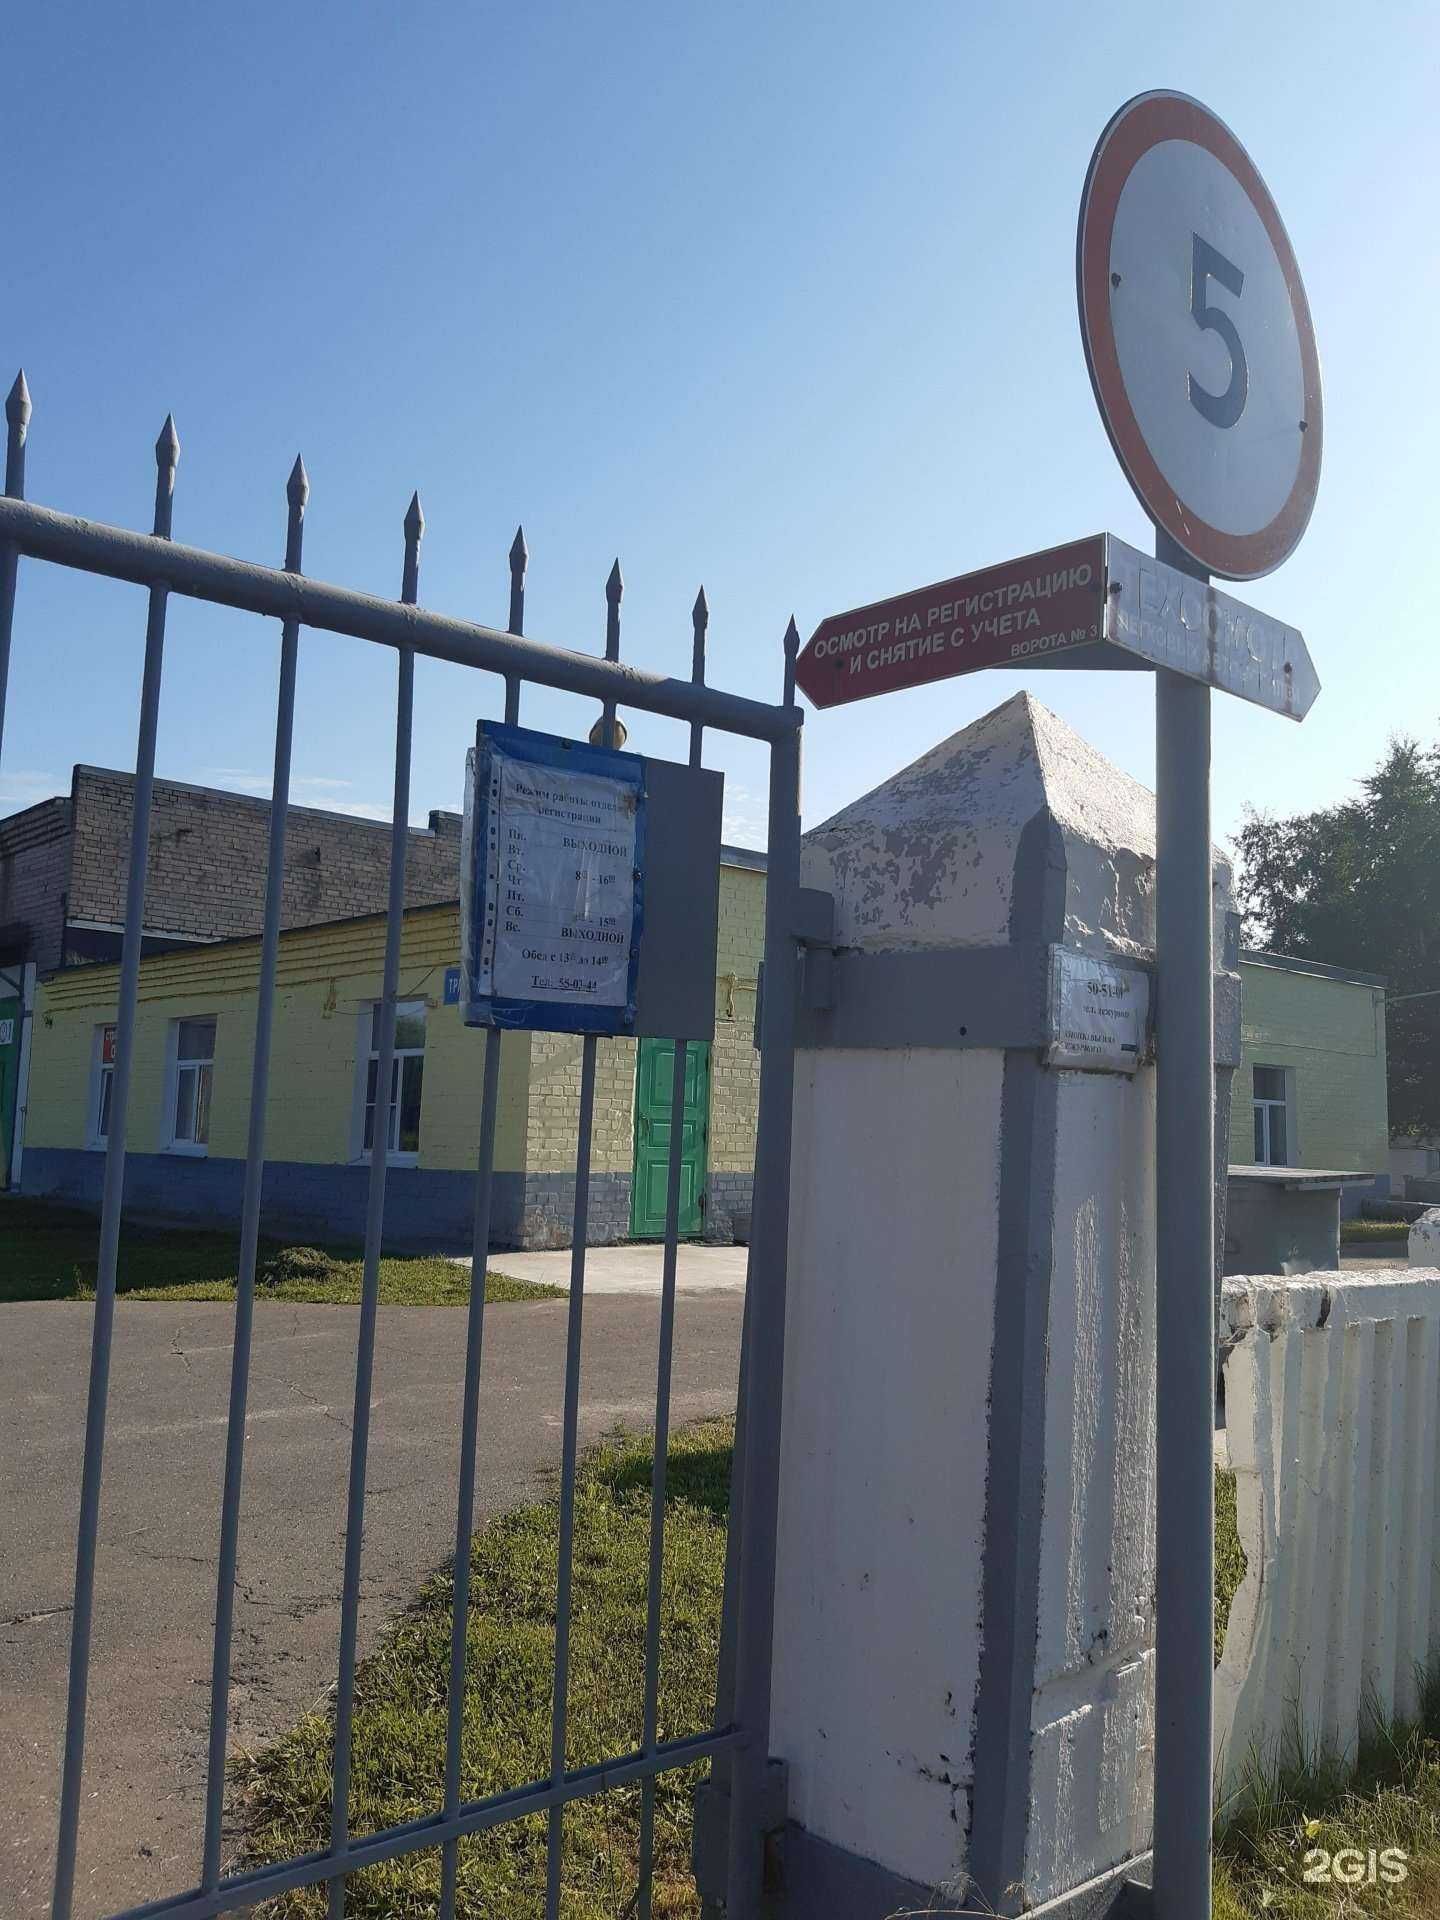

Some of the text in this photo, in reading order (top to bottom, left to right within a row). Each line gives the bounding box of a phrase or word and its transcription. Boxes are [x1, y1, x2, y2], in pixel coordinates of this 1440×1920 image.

[1186, 231, 1249, 430] 5
[814, 563, 1093, 658] ОСМОТР НА РЕГИСТРАЦИЮ
[849, 607, 1041, 674] И СНЯТИЕ С УЧЕТА
[1011, 623, 1099, 657] ВОРОТА № 3
[515, 783, 550, 799] Режим
[505, 905, 524, 917] Сб.
[505, 921, 521, 933] Вс.
